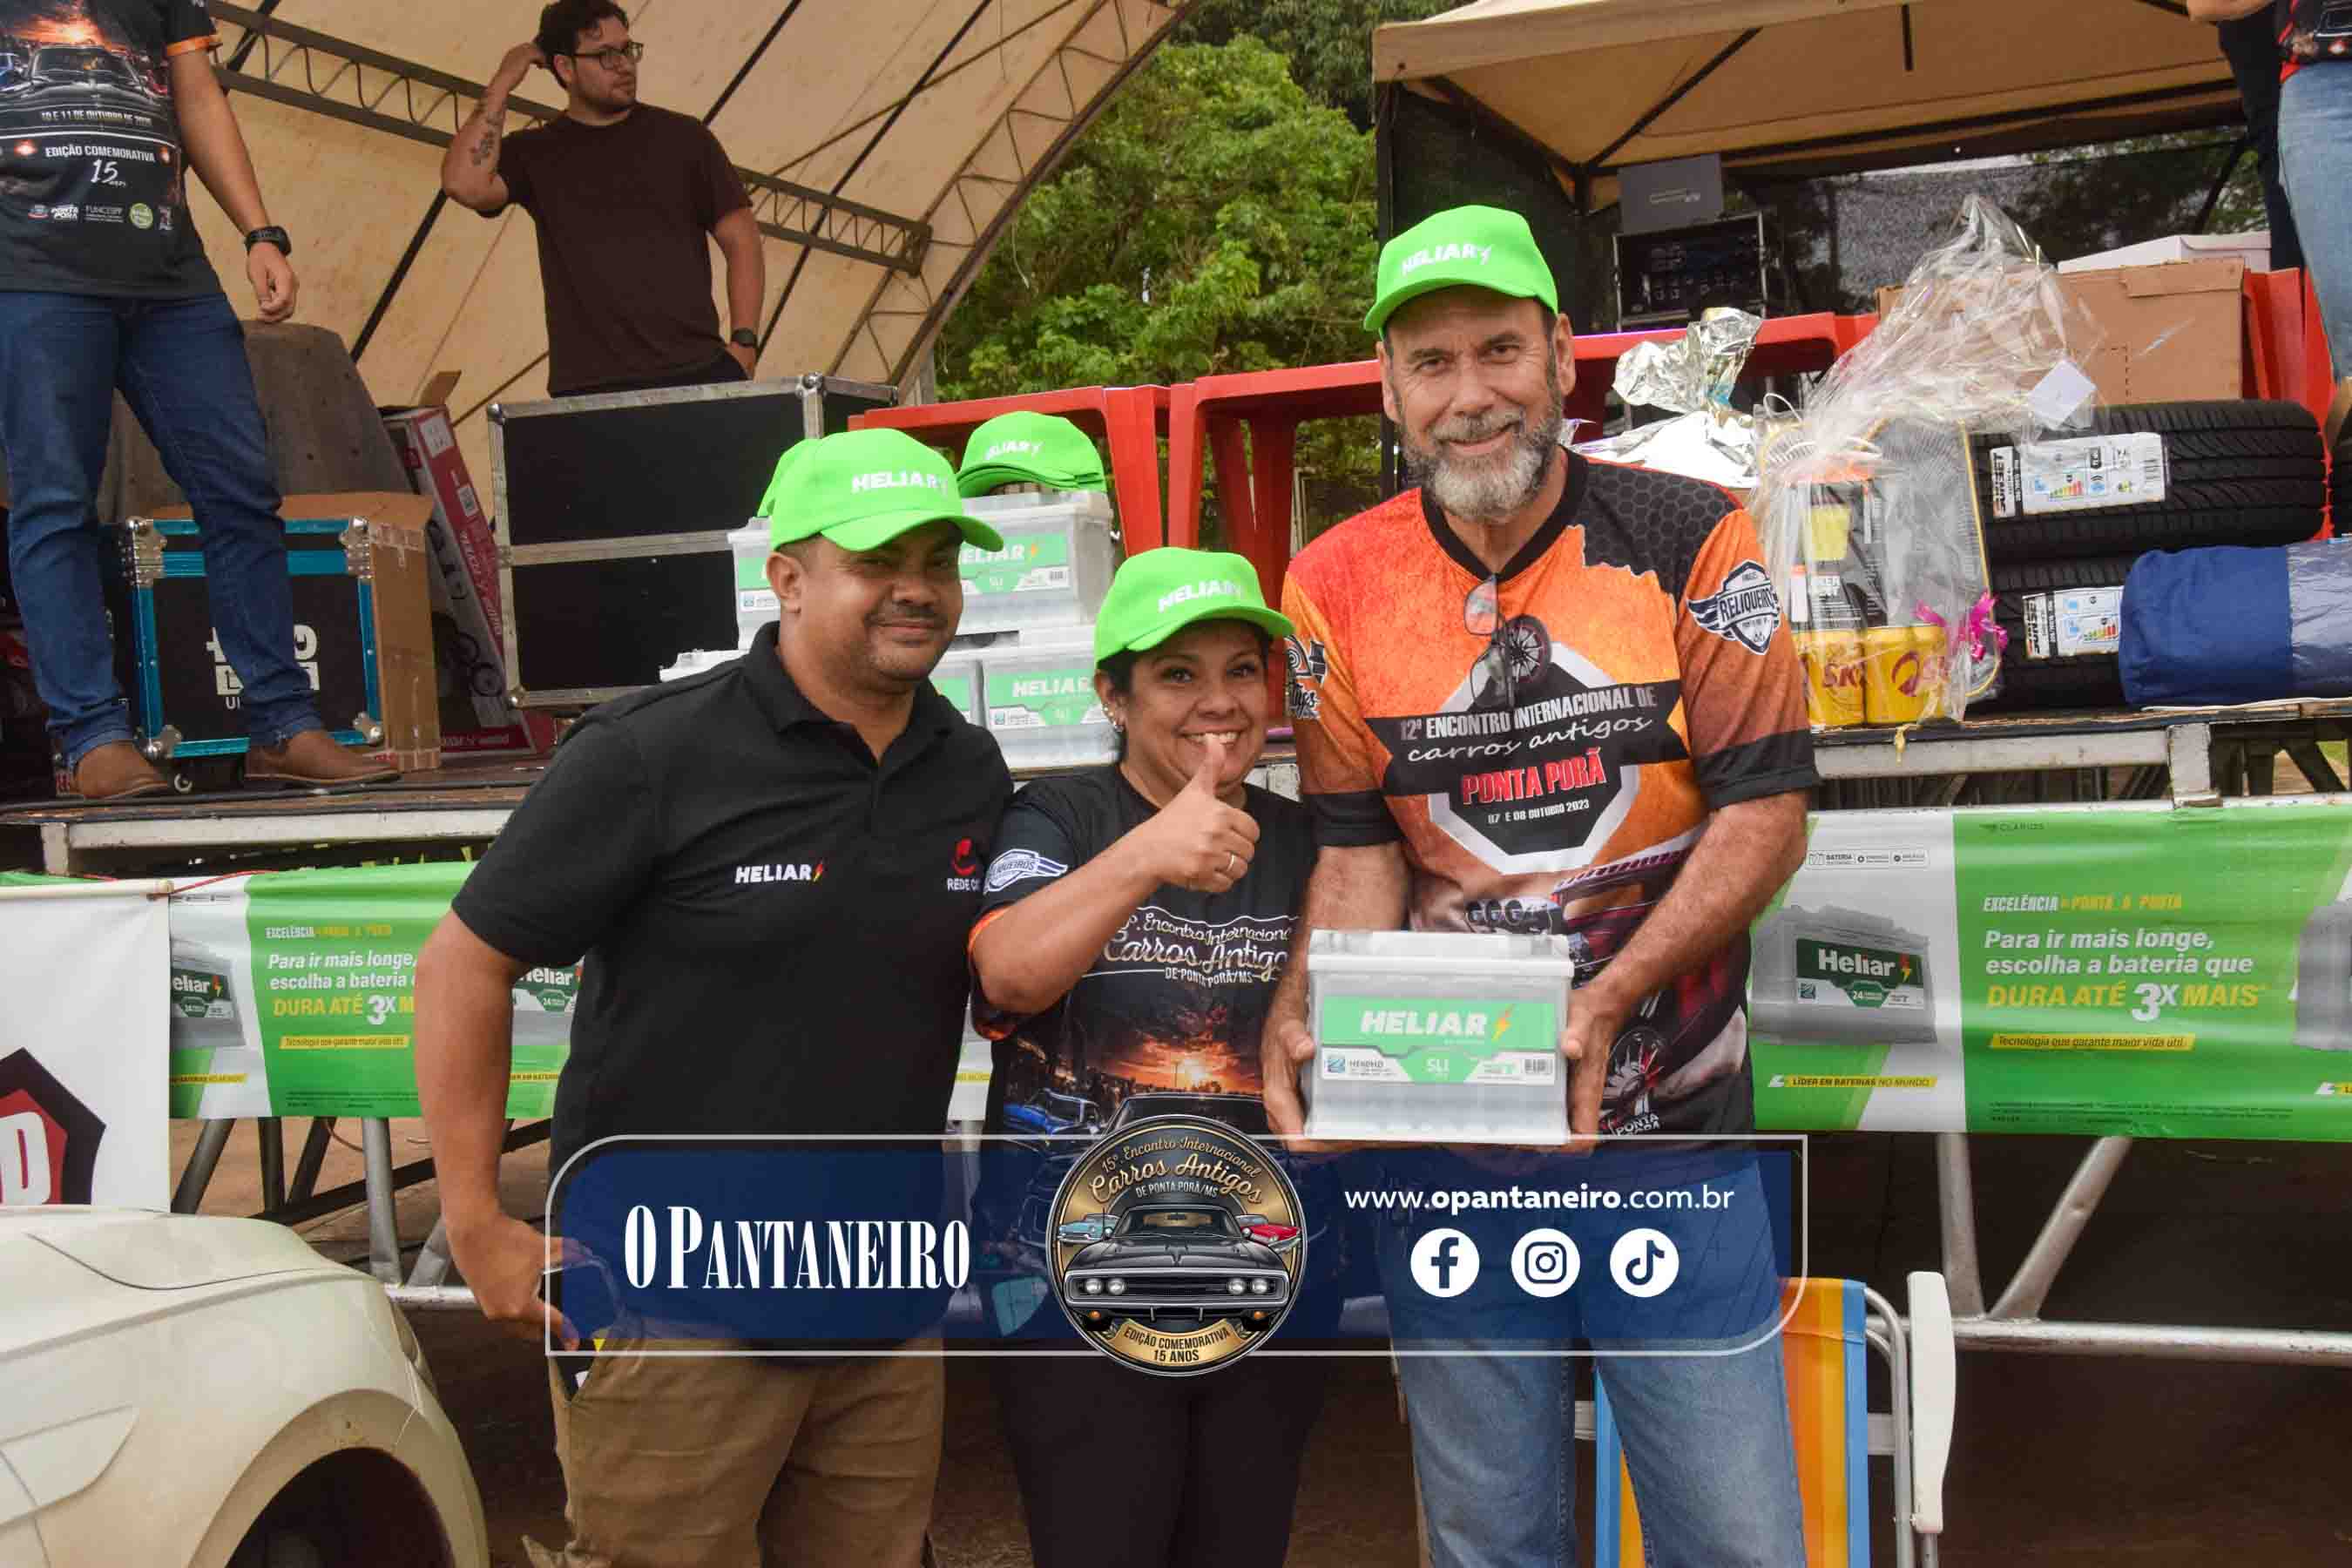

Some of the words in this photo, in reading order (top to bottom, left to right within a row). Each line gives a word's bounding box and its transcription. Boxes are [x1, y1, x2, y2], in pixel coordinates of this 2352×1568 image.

[45, 144, 83, 158] EDIÇÃO
[84, 145, 155, 162] COMEMORATIVA
[91, 159, 118, 183] 15
[852, 471, 941, 494] HELIAR
[962, 544, 1025, 564] ELIAR
[1158, 580, 1235, 612] HELIAR
[1426, 711, 1511, 740] ENCONTRO
[1513, 686, 1634, 730] INTERNACIONAL
[1636, 686, 1658, 707] DE
[1408, 740, 1522, 762] carros
[1529, 717, 1652, 748] antigos
[1462, 766, 1544, 806] PONTA
[1544, 747, 1608, 794] PORÃ
[1488, 814, 1500, 825] 07
[1505, 811, 1511, 822] E
[1513, 809, 1526, 821] 08
[1528, 804, 1565, 819] OUTUBRO
[1566, 799, 1590, 813] 2023
[735, 864, 812, 884] HELIAR
[948, 878, 970, 891] REDE
[1984, 895, 2058, 912] EXCELÊNCIA
[1144, 913, 1206, 940] Encontro
[1984, 929, 2040, 948] Para
[2047, 929, 2065, 948] ir
[2071, 929, 2130, 948] mais
[2136, 928, 2214, 951] longe,
[268, 954, 305, 969] Para
[308, 952, 322, 967] ir
[325, 950, 363, 967] mais
[367, 950, 418, 969] longe,
[1104, 937, 1202, 966] Carros
[1818, 948, 1896, 977] Heliar
[1166, 967, 1178, 979] DE
[1180, 970, 1206, 986] PONTA
[1985, 955, 2081, 975] escolha
[2087, 960, 2101, 974] a
[2108, 954, 2199, 974] bateria
[2205, 957, 2253, 978] que
[172, 975, 210, 993] eliar
[270, 972, 332, 990] escolha
[335, 977, 346, 990] a
[350, 972, 407, 989] bateria
[273, 998, 325, 1017] DURA
[329, 992, 363, 1017] ATÉ
[1853, 990, 1863, 1000] 24
[1987, 984, 2065, 1007] DURA
[2072, 980, 2126, 1007] ATÉ
[1361, 1010, 1488, 1036] HELIAR
[1999, 1036, 2049, 1048] Tecnologia
[2051, 1037, 2071, 1048] que
[2073, 1037, 2111, 1048] garante
[2112, 1037, 2141, 1047] maior
[2143, 1036, 2165, 1047] vida
[1835, 1078, 1876, 1087] BATERIAS
